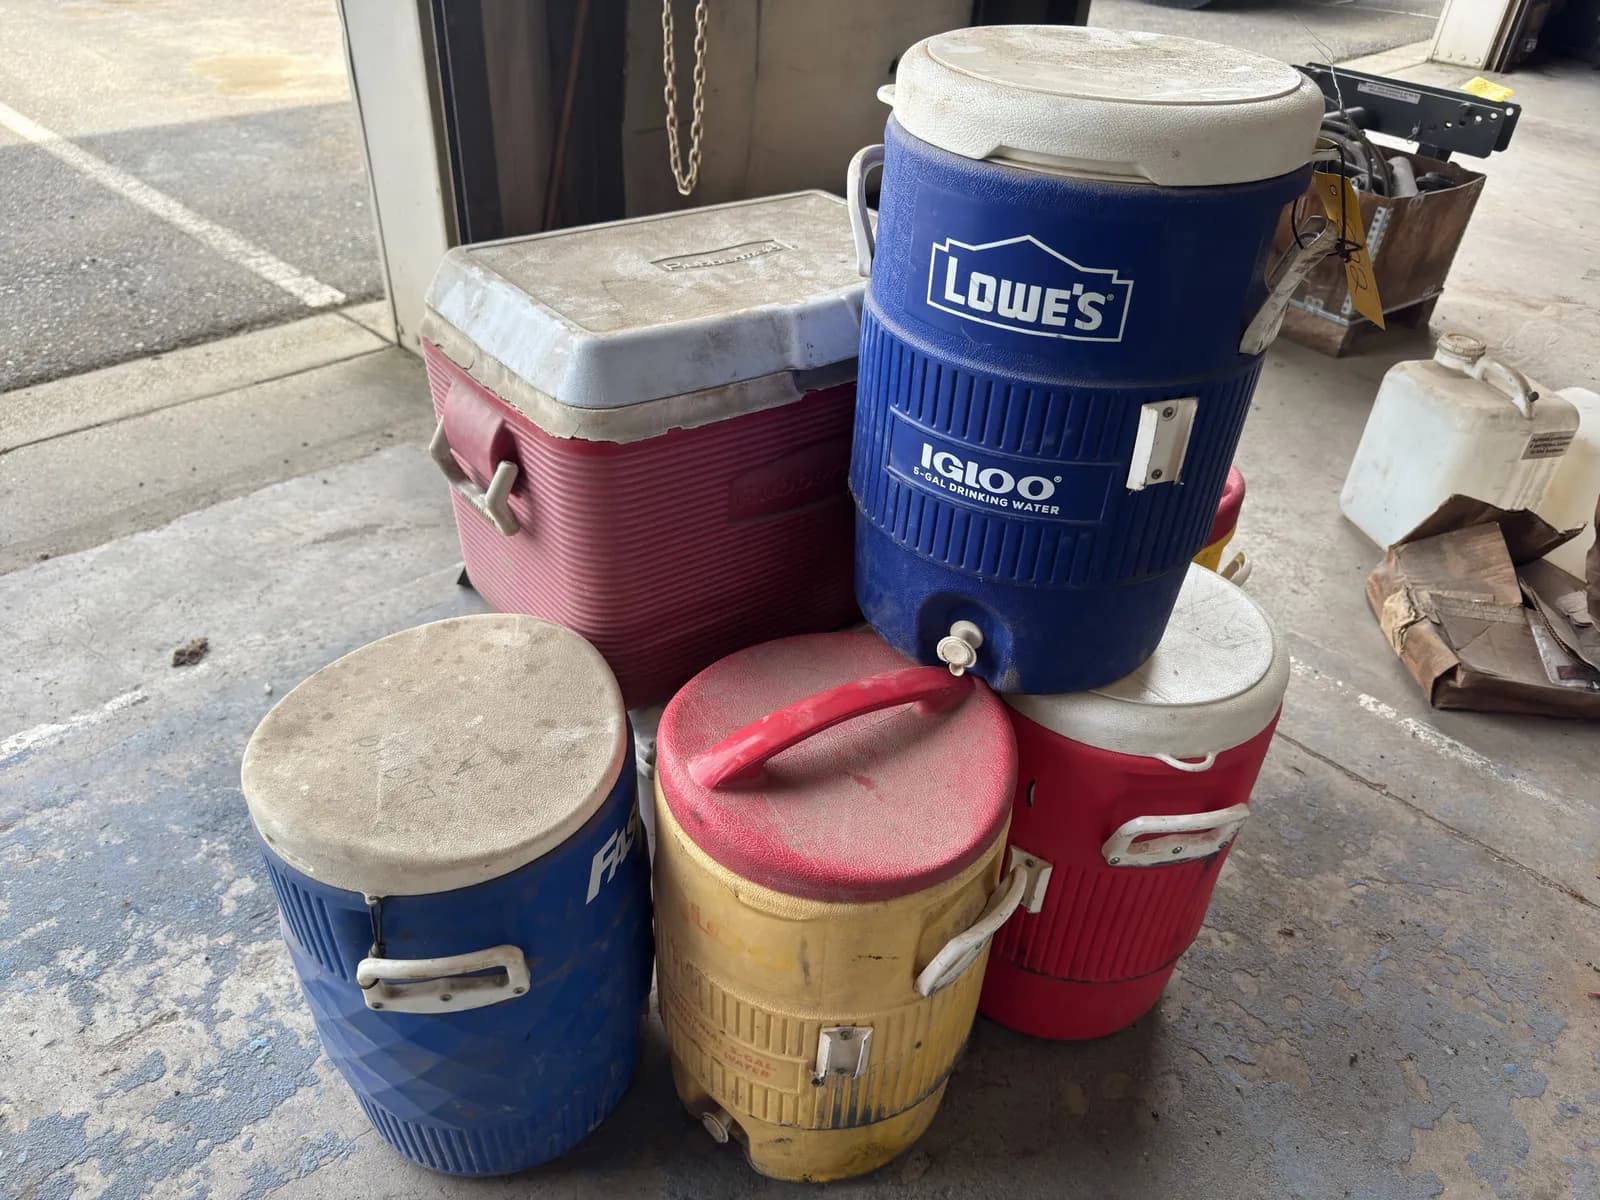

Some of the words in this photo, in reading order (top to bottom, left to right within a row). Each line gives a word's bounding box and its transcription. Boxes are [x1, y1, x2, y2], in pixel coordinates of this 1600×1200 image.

[944, 255, 1106, 330] LOWE'S
[912, 466, 947, 489] 5-GAL
[948, 483, 1009, 507] DRINKING
[1012, 500, 1061, 515] WATER
[920, 443, 1056, 501] IGLOO
[586, 805, 638, 905] FAS
